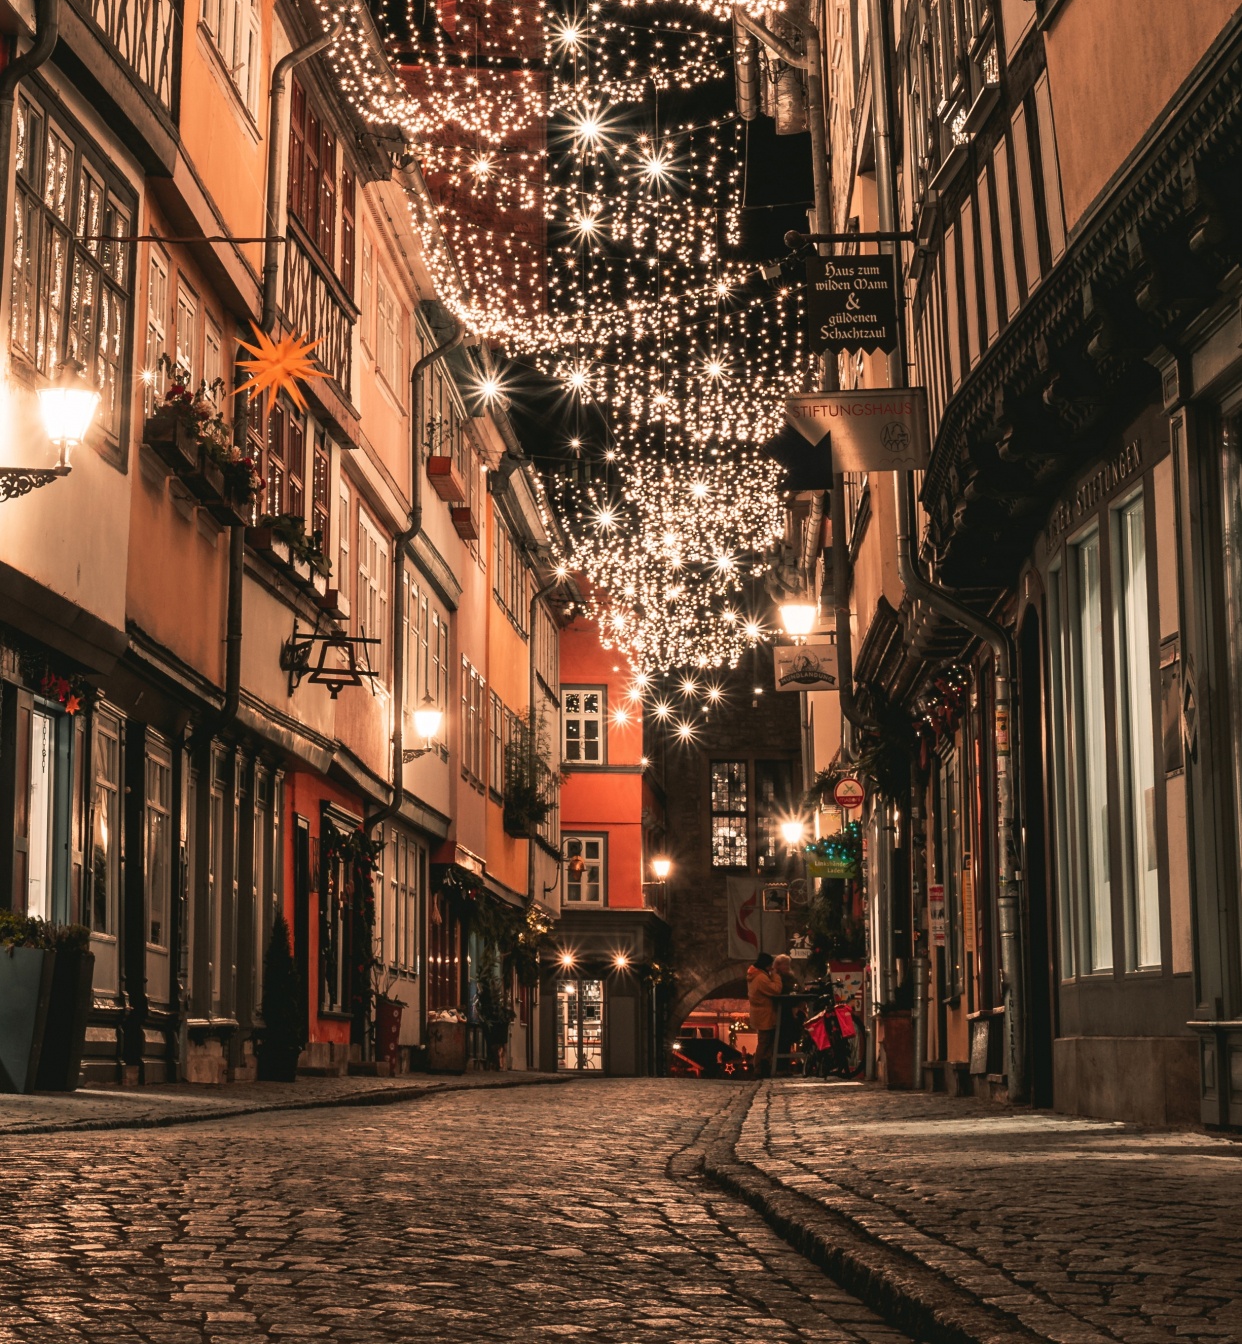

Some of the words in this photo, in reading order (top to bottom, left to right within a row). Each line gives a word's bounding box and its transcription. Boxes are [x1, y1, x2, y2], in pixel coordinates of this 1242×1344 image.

[825, 261, 854, 278] Haus
[857, 266, 880, 275] zum
[815, 279, 850, 290] wilden
[854, 279, 888, 289] Mann
[845, 292, 861, 311] &
[828, 313, 877, 326] güldenen
[820, 325, 886, 339] Schachtzaul
[792, 402, 912, 418] STIFTUNGSHAUS
[1076, 439, 1143, 516] STIFTUNGEN
[781, 672, 833, 684] MUNDLANDUNG
